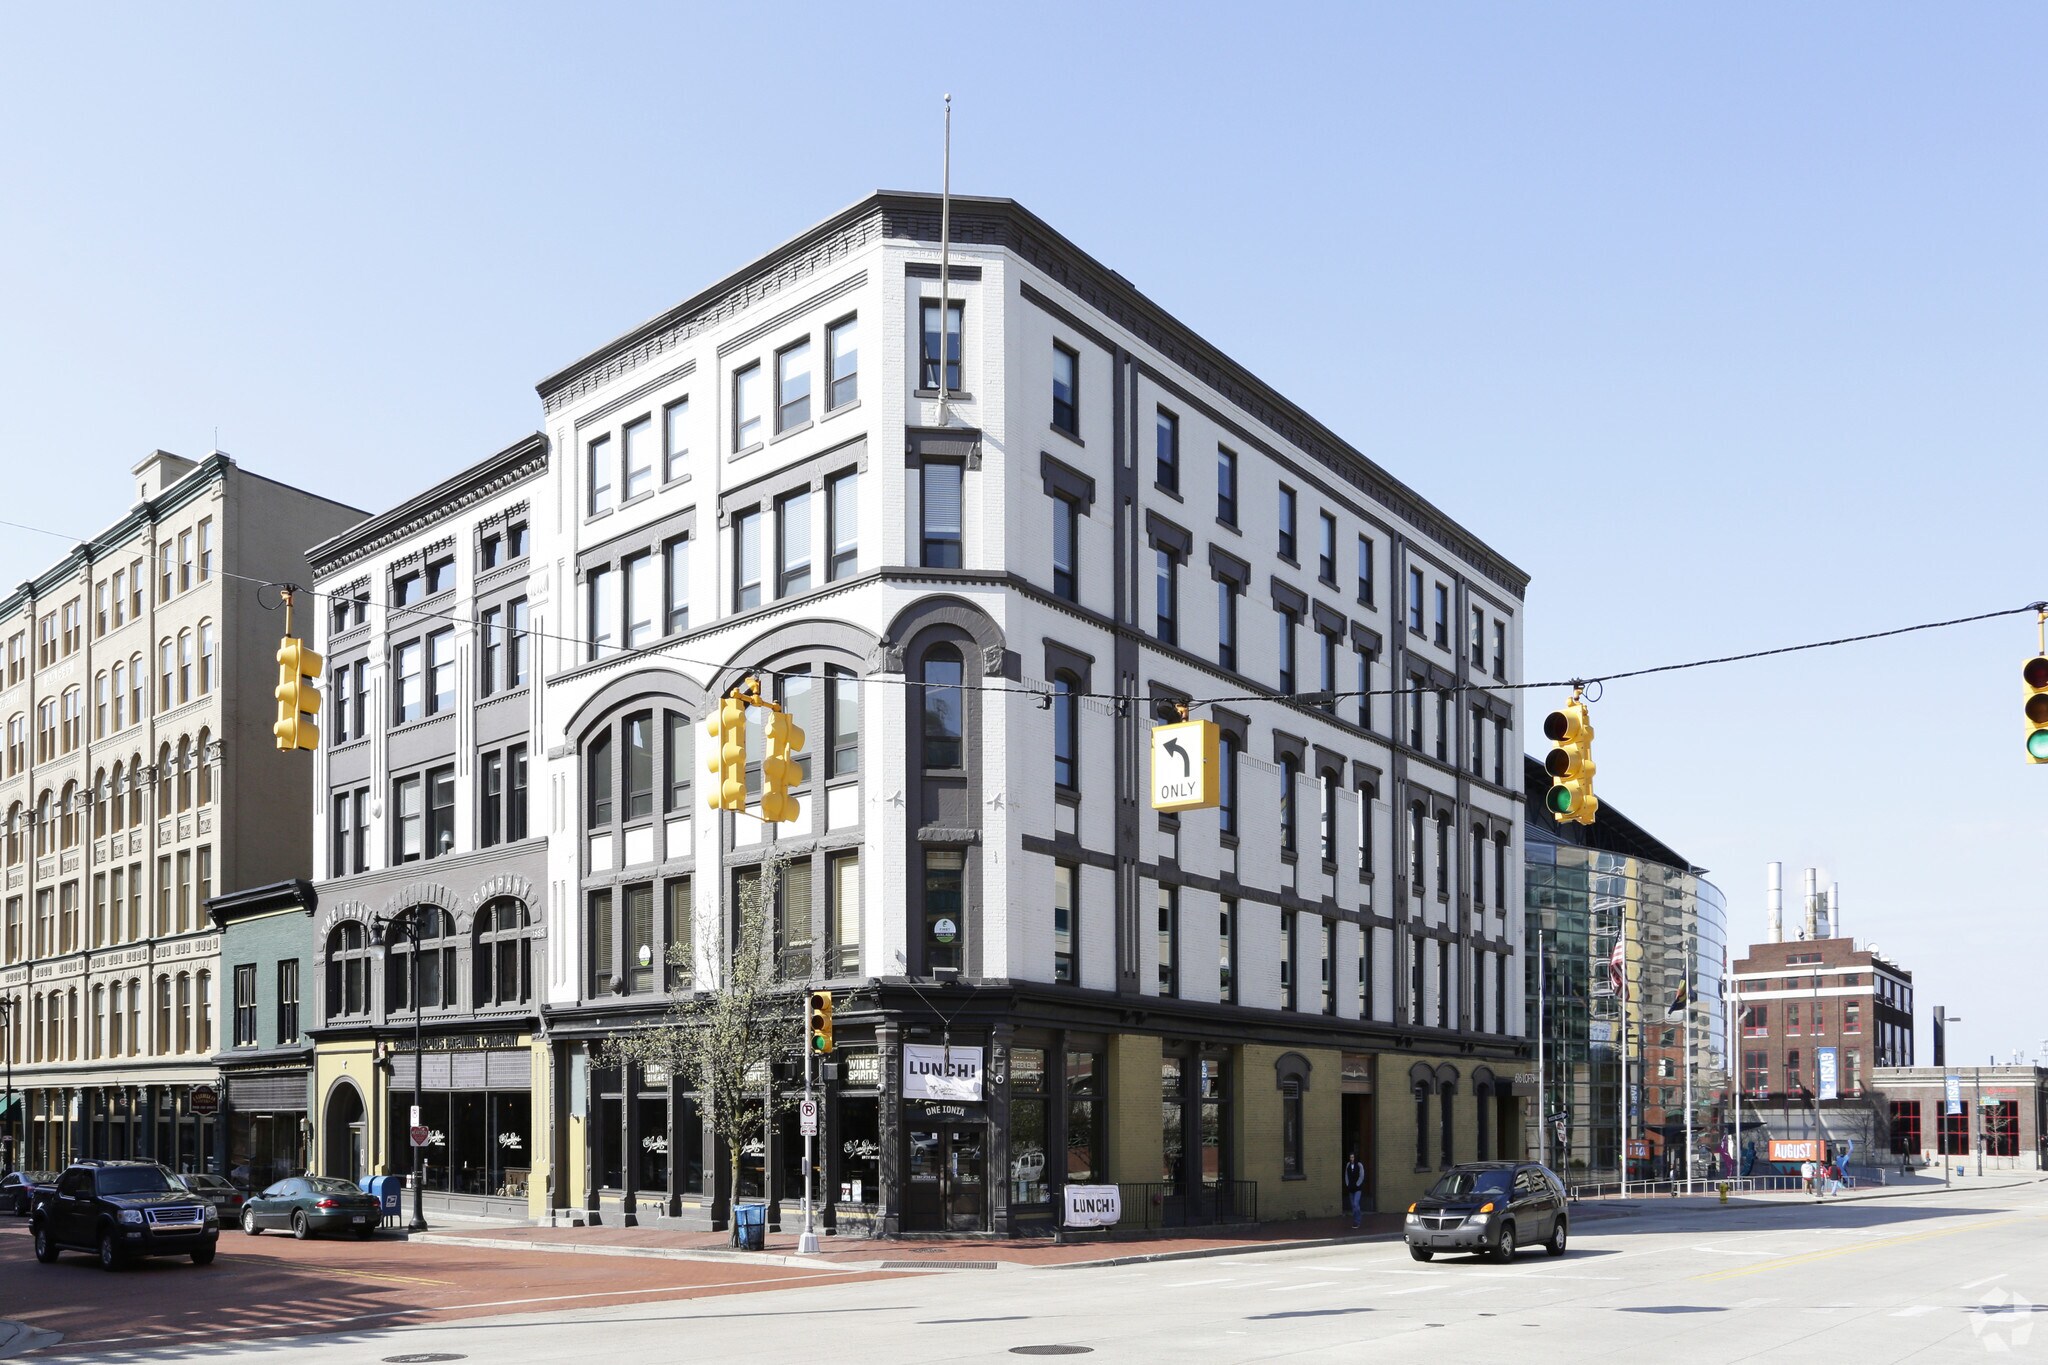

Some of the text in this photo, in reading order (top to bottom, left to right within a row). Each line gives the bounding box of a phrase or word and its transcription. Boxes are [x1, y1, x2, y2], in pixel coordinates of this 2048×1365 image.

[1161, 781, 1196, 799] ONLY
[473, 877, 529, 904] COMPANY
[394, 1039, 416, 1050] GRAND
[447, 1035, 479, 1049] BREWING
[480, 1033, 519, 1048] COMPANY
[848, 1059, 870, 1070] WINE
[909, 1061, 976, 1078] LUNCH!
[1820, 1053, 1835, 1082] GVSU
[848, 1069, 879, 1081] SPIRITS
[1011, 1070, 1039, 1080] BRUNCH
[1948, 1080, 1959, 1101] GVSU
[925, 1105, 965, 1116] ONE IONIA
[1774, 1143, 1811, 1159] AUGUST
[1073, 1198, 1115, 1213] LUNCH!
